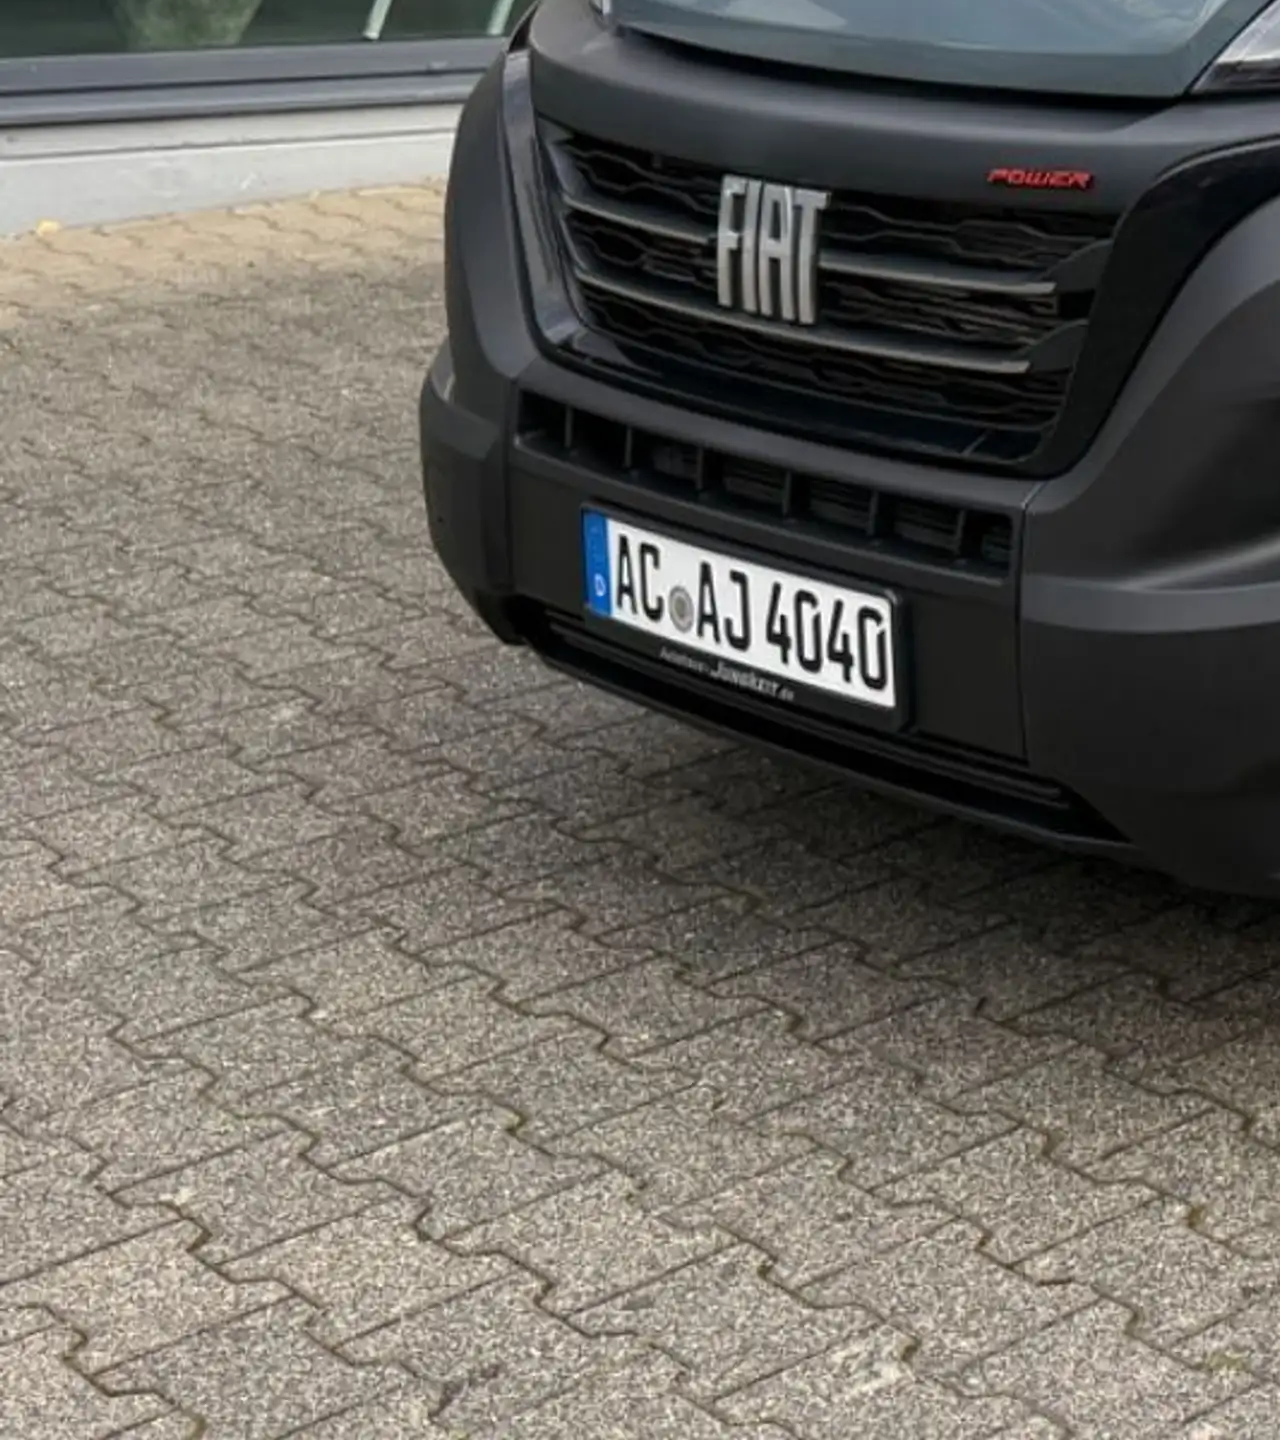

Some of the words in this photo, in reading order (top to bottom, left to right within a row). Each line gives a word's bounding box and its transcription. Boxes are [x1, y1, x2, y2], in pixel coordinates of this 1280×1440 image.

[717, 173, 832, 326] FIAT
[986, 168, 1094, 190] POWER
[616, 533, 664, 622] AC
[697, 560, 749, 652] AJ
[765, 582, 888, 691] 4040
